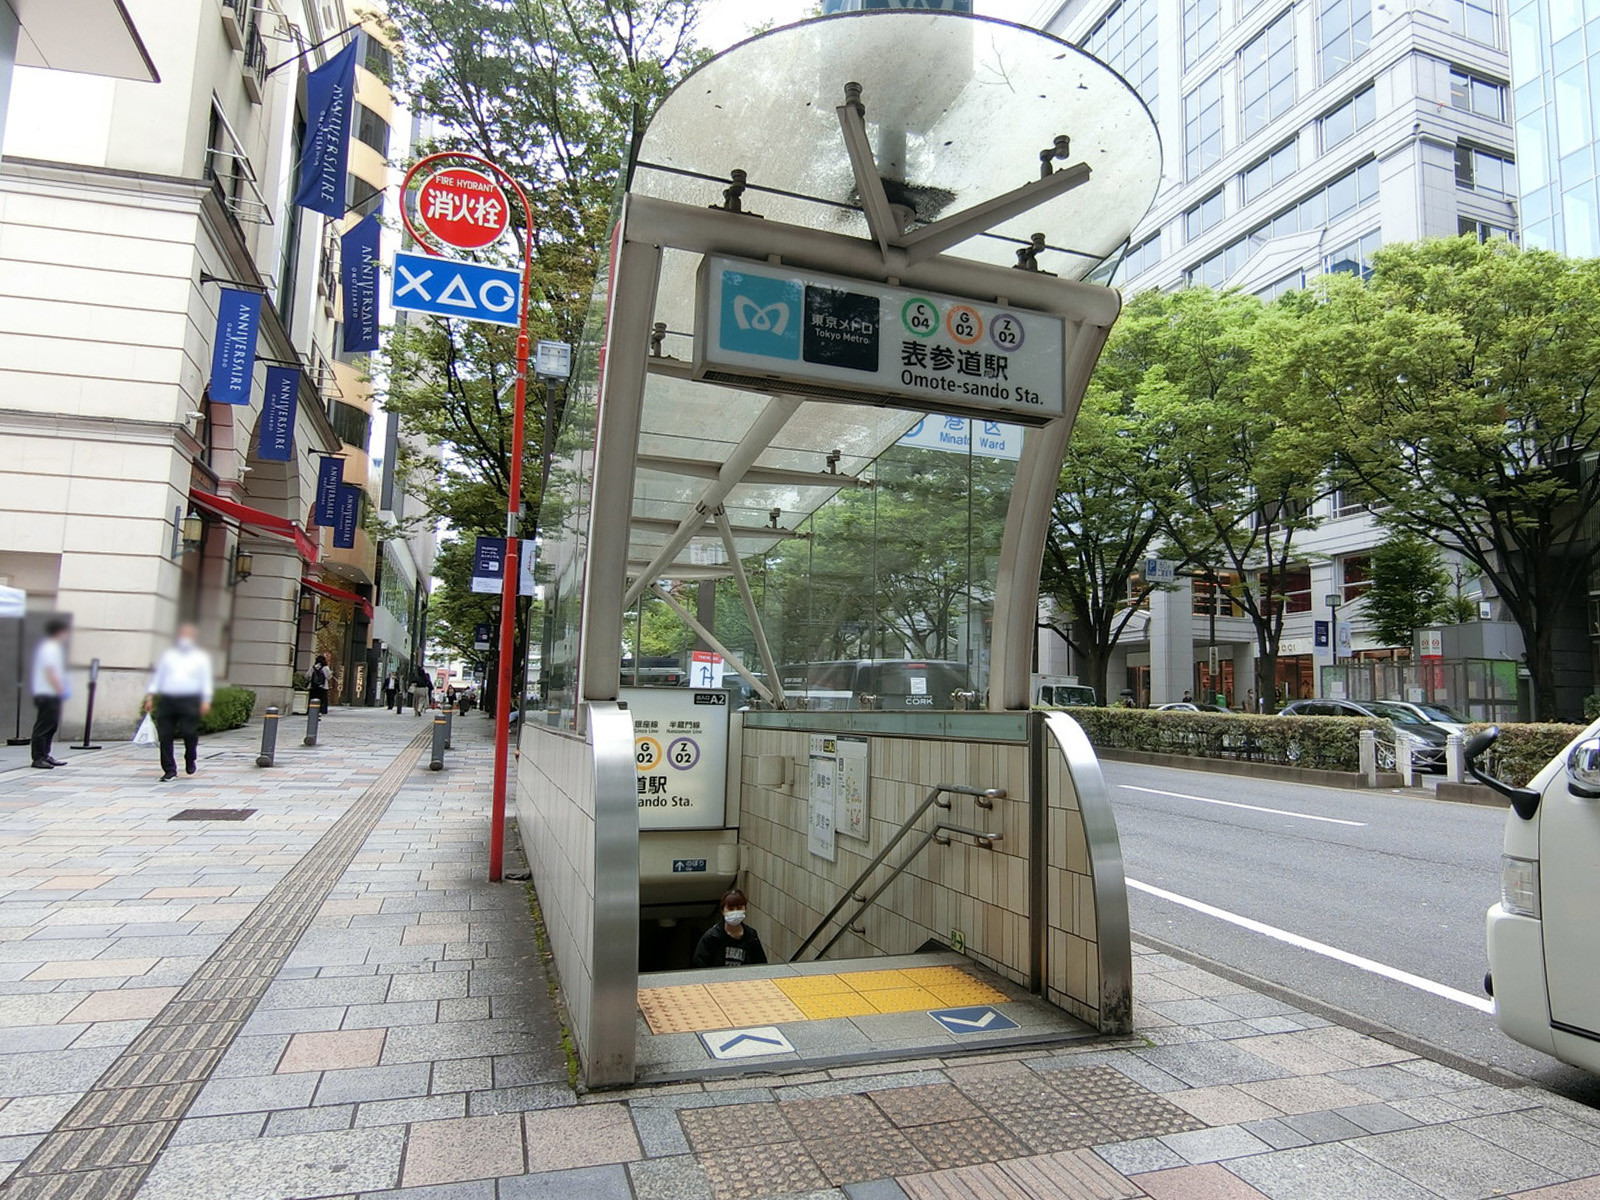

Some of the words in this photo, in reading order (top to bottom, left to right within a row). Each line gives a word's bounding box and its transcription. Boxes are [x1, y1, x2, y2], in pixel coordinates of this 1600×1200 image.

[435, 175, 454, 186] FIRE
[456, 178, 495, 193] HYDRANT
[427, 188, 502, 229] 消火栓
[357, 245, 373, 341] ANNIVERSAIRE
[917, 305, 925, 315] C
[811, 314, 873, 335] 東京メトロ
[911, 316, 930, 330] 04
[960, 312, 970, 323] G
[955, 323, 974, 337] 02
[1003, 319, 1011, 331] Z
[814, 327, 841, 341] Tokyo
[842, 332, 869, 345] Metro
[998, 331, 1016, 344] 02
[230, 304, 250, 391] ANNIVERSAIRE
[901, 340, 1009, 381] 表参道駅
[901, 369, 1010, 400] Omote-sando
[1015, 386, 1044, 405] Sta.
[275, 378, 291, 450] ANNIVERSAIRE
[979, 436, 1006, 451] Ward
[709, 695, 725, 705] A2
[905, 698, 934, 706] CORK
[641, 742, 650, 752] G
[680, 743, 688, 752] Z
[637, 753, 653, 763] 02
[675, 753, 691, 763] 02
[672, 796, 693, 807] Sta.
